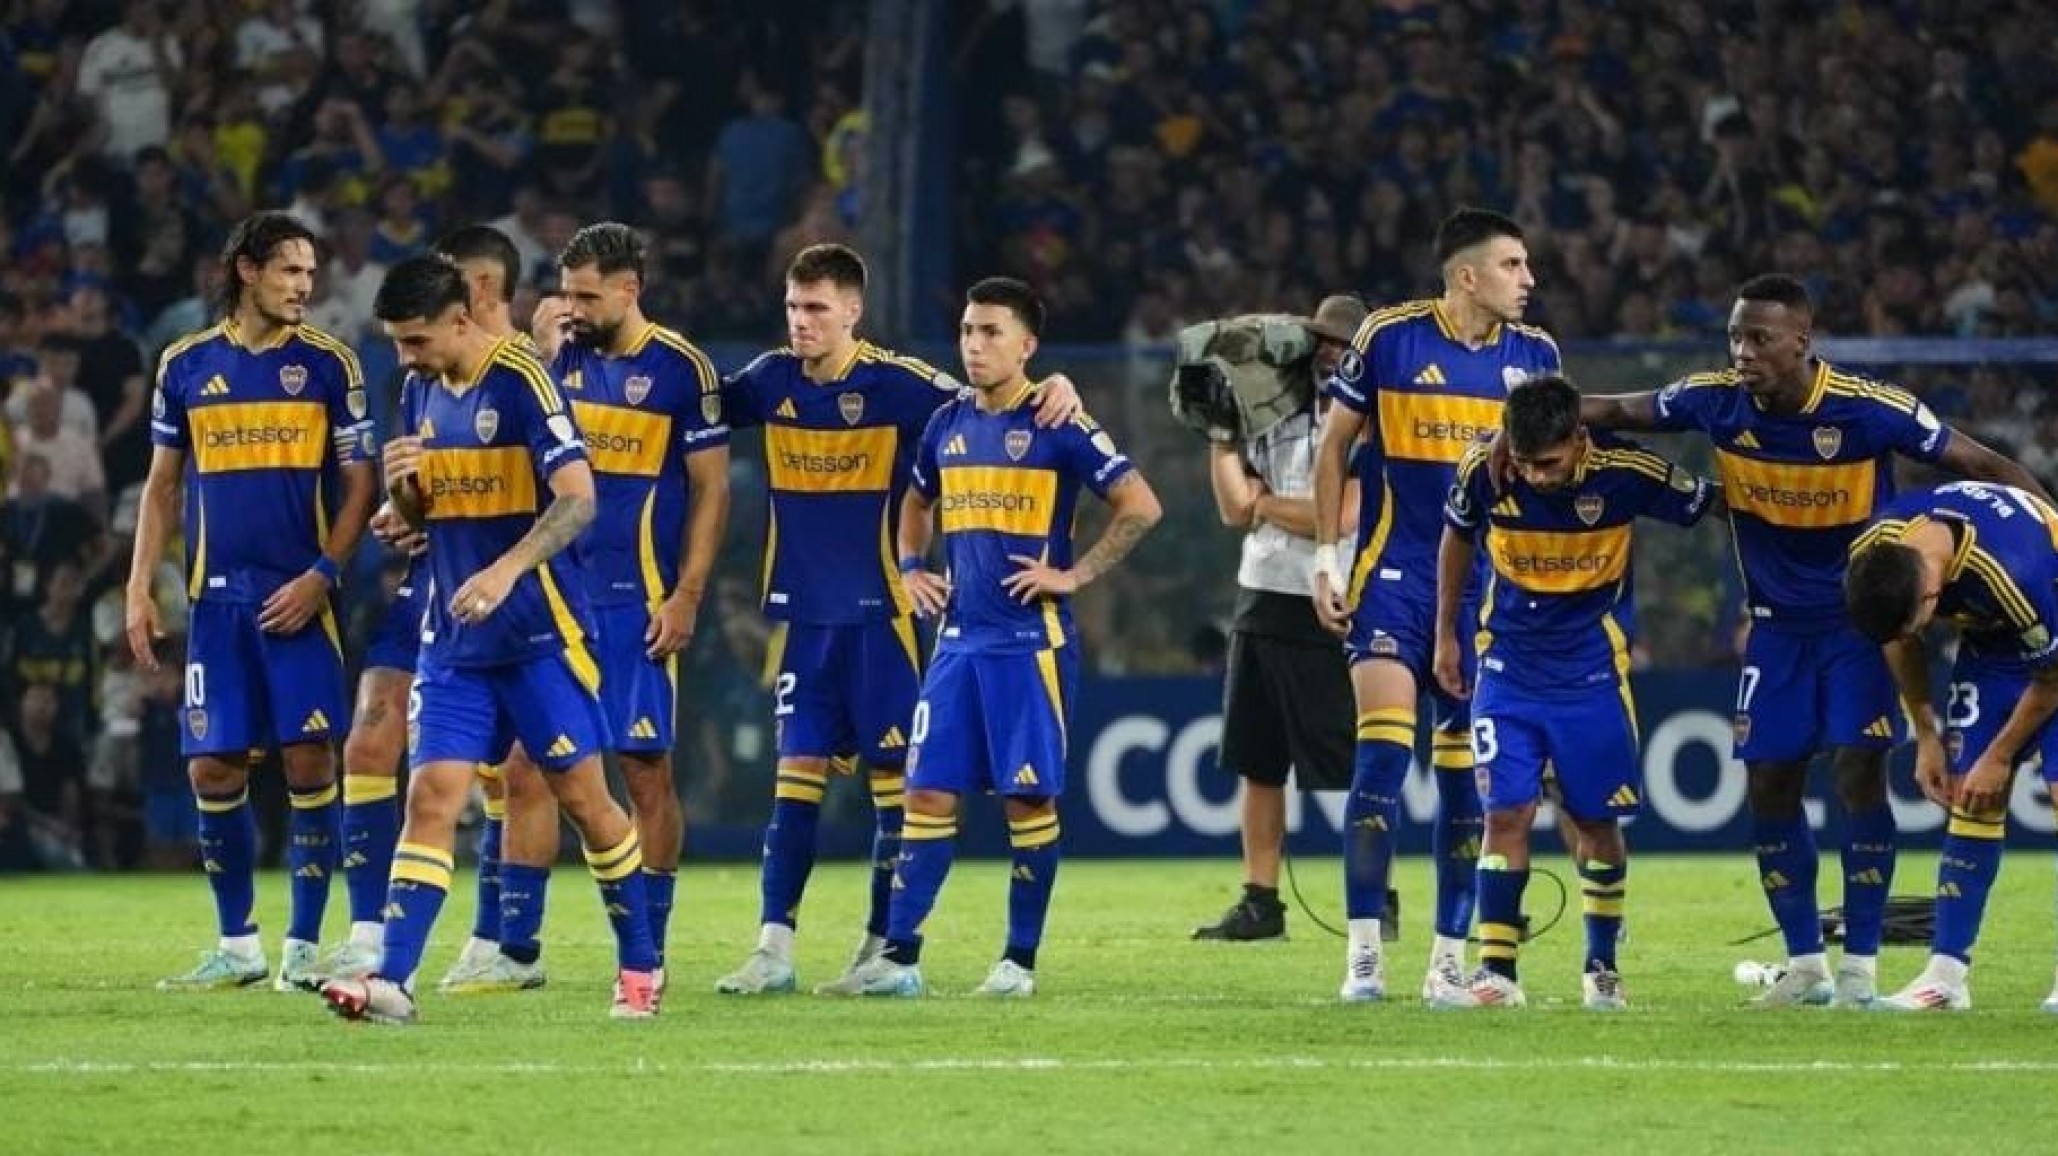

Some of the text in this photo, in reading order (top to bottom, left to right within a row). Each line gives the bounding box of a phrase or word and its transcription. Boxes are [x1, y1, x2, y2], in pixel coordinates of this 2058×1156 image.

[205, 424, 308, 448] betsson
[1413, 416, 1496, 442] bets
[582, 431, 642, 457] sson
[779, 446, 868, 474] betsson
[430, 474, 506, 498] etsson
[1732, 474, 1849, 507] betsson
[942, 487, 1034, 512] betsson
[1501, 550, 1614, 574] betsson
[775, 671, 797, 715] 2
[1946, 681, 1980, 728] 23
[910, 700, 931, 746] 0
